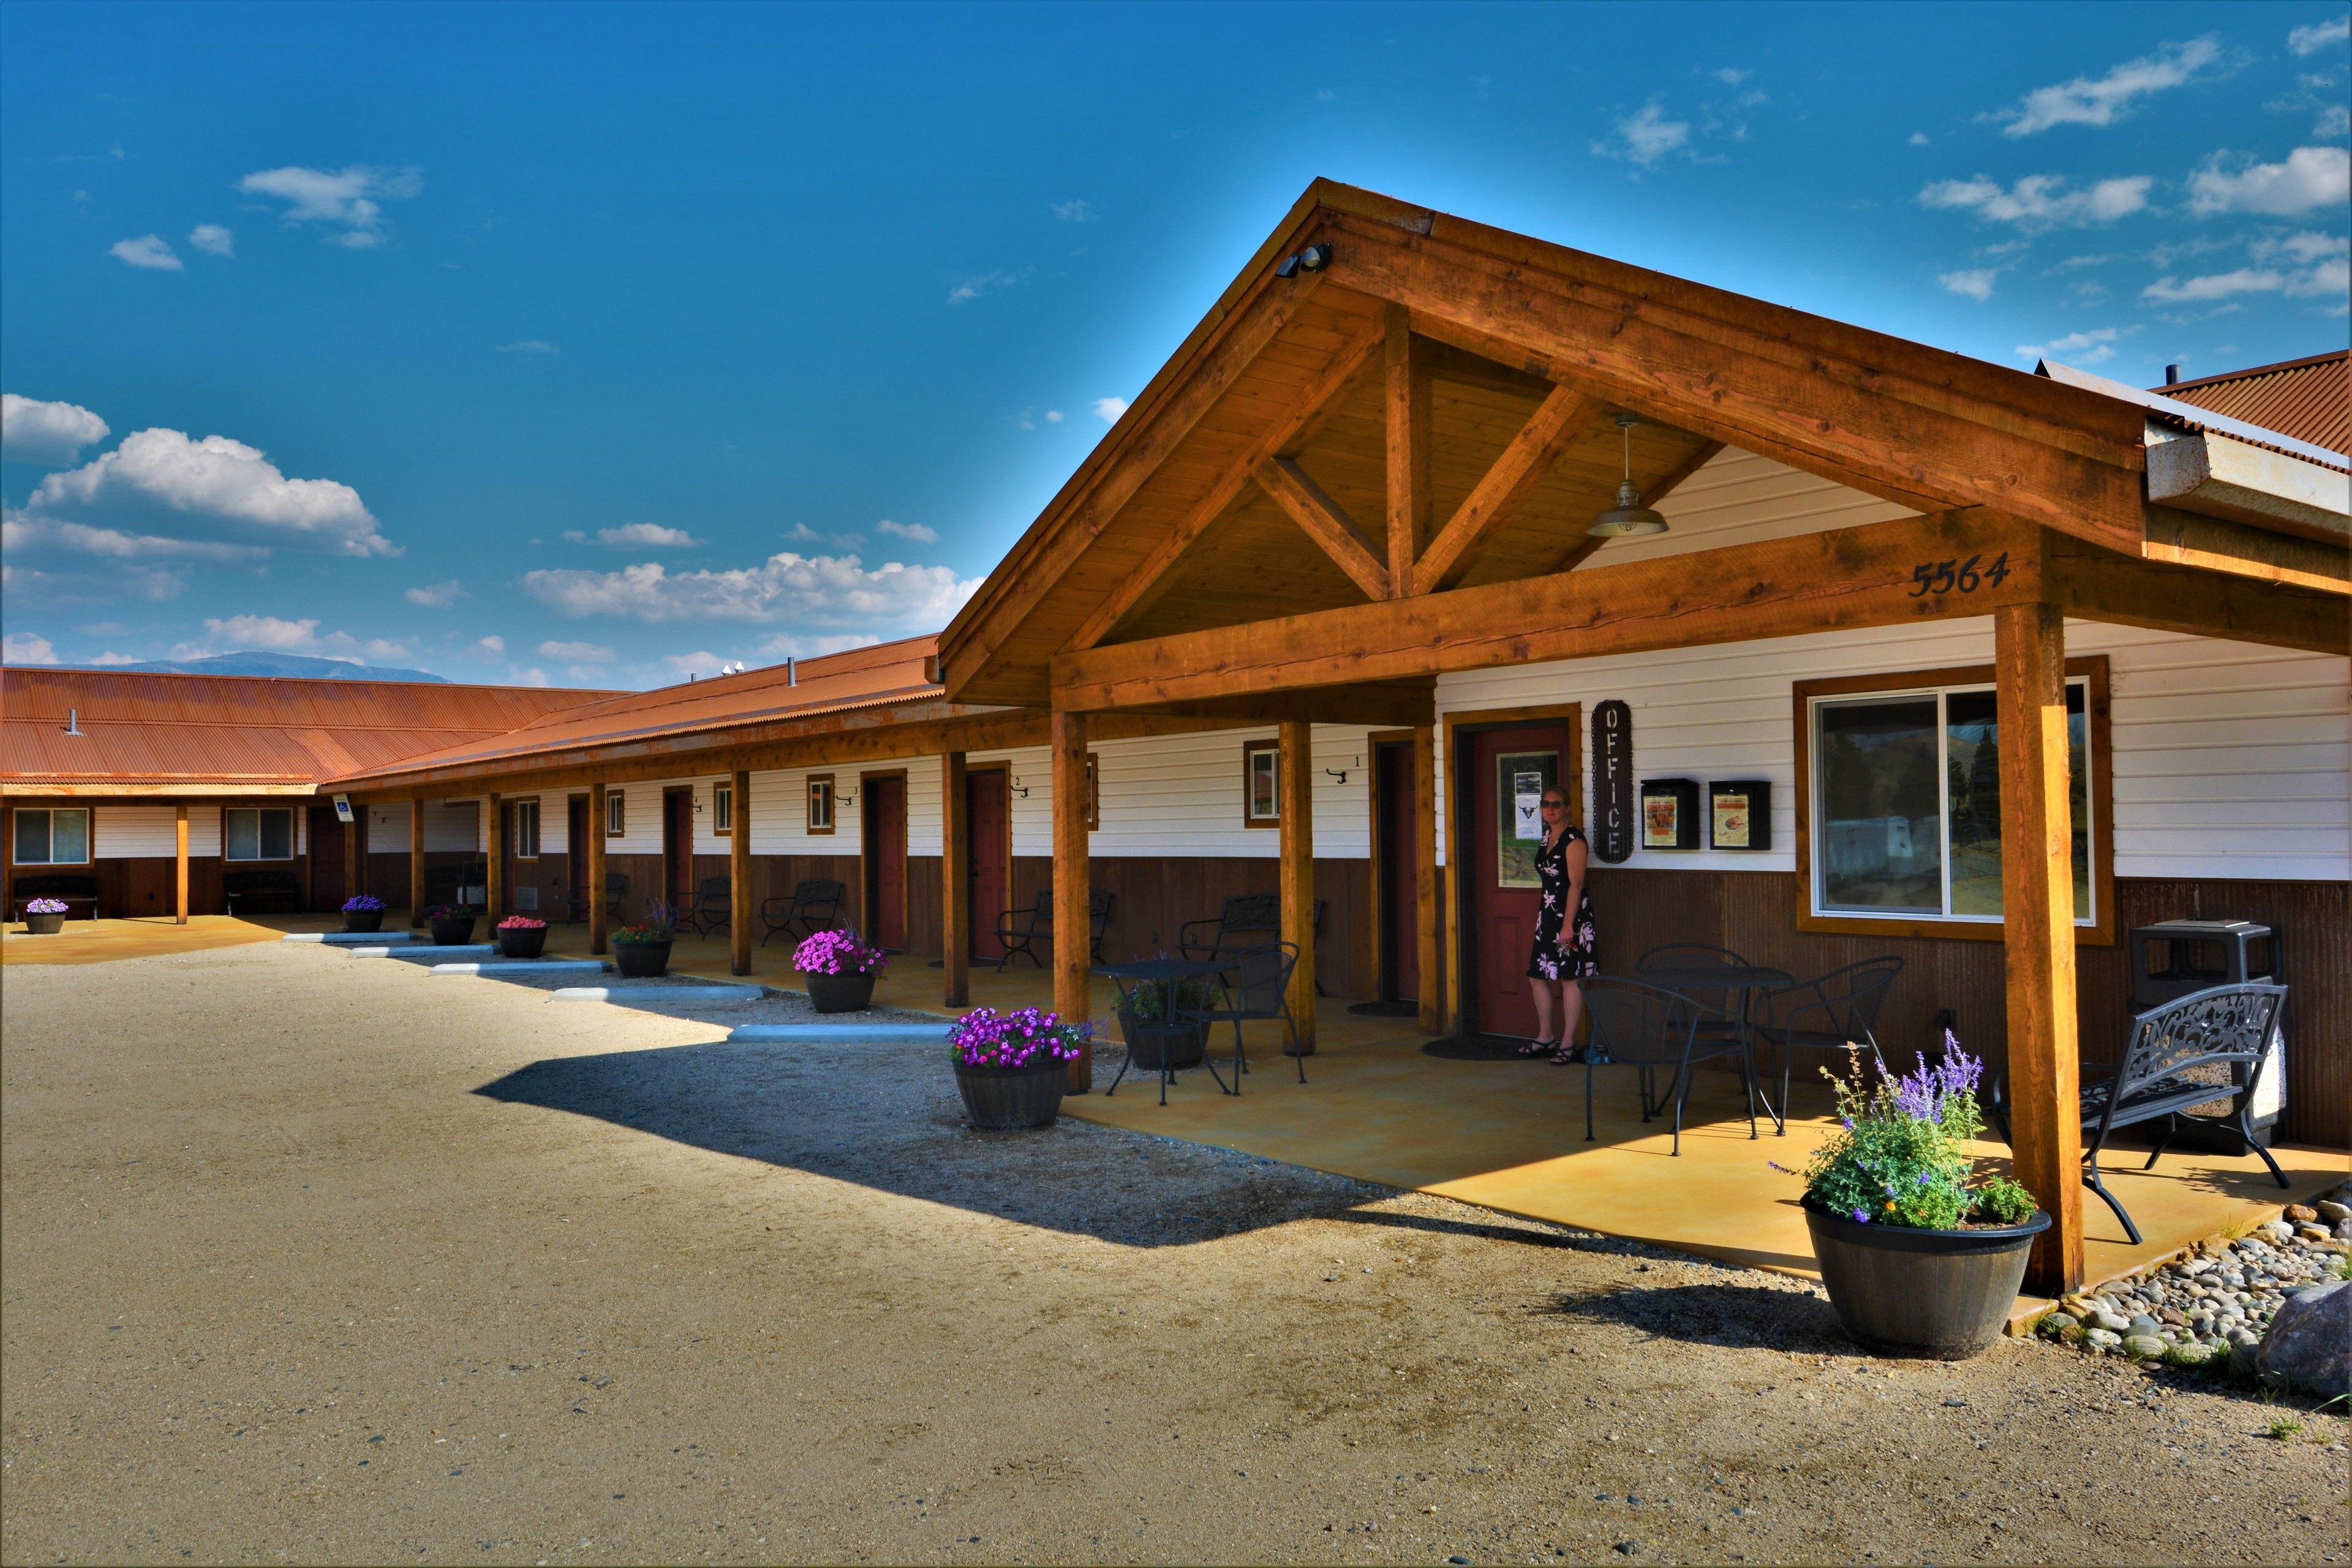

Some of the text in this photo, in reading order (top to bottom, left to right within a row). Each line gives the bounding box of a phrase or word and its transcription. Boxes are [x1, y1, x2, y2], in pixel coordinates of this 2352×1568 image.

[1908, 552, 2010, 597] 5564
[1355, 756, 1360, 767] 1
[1016, 777, 1020, 785] 2
[1606, 708, 1620, 854] OFFICE
